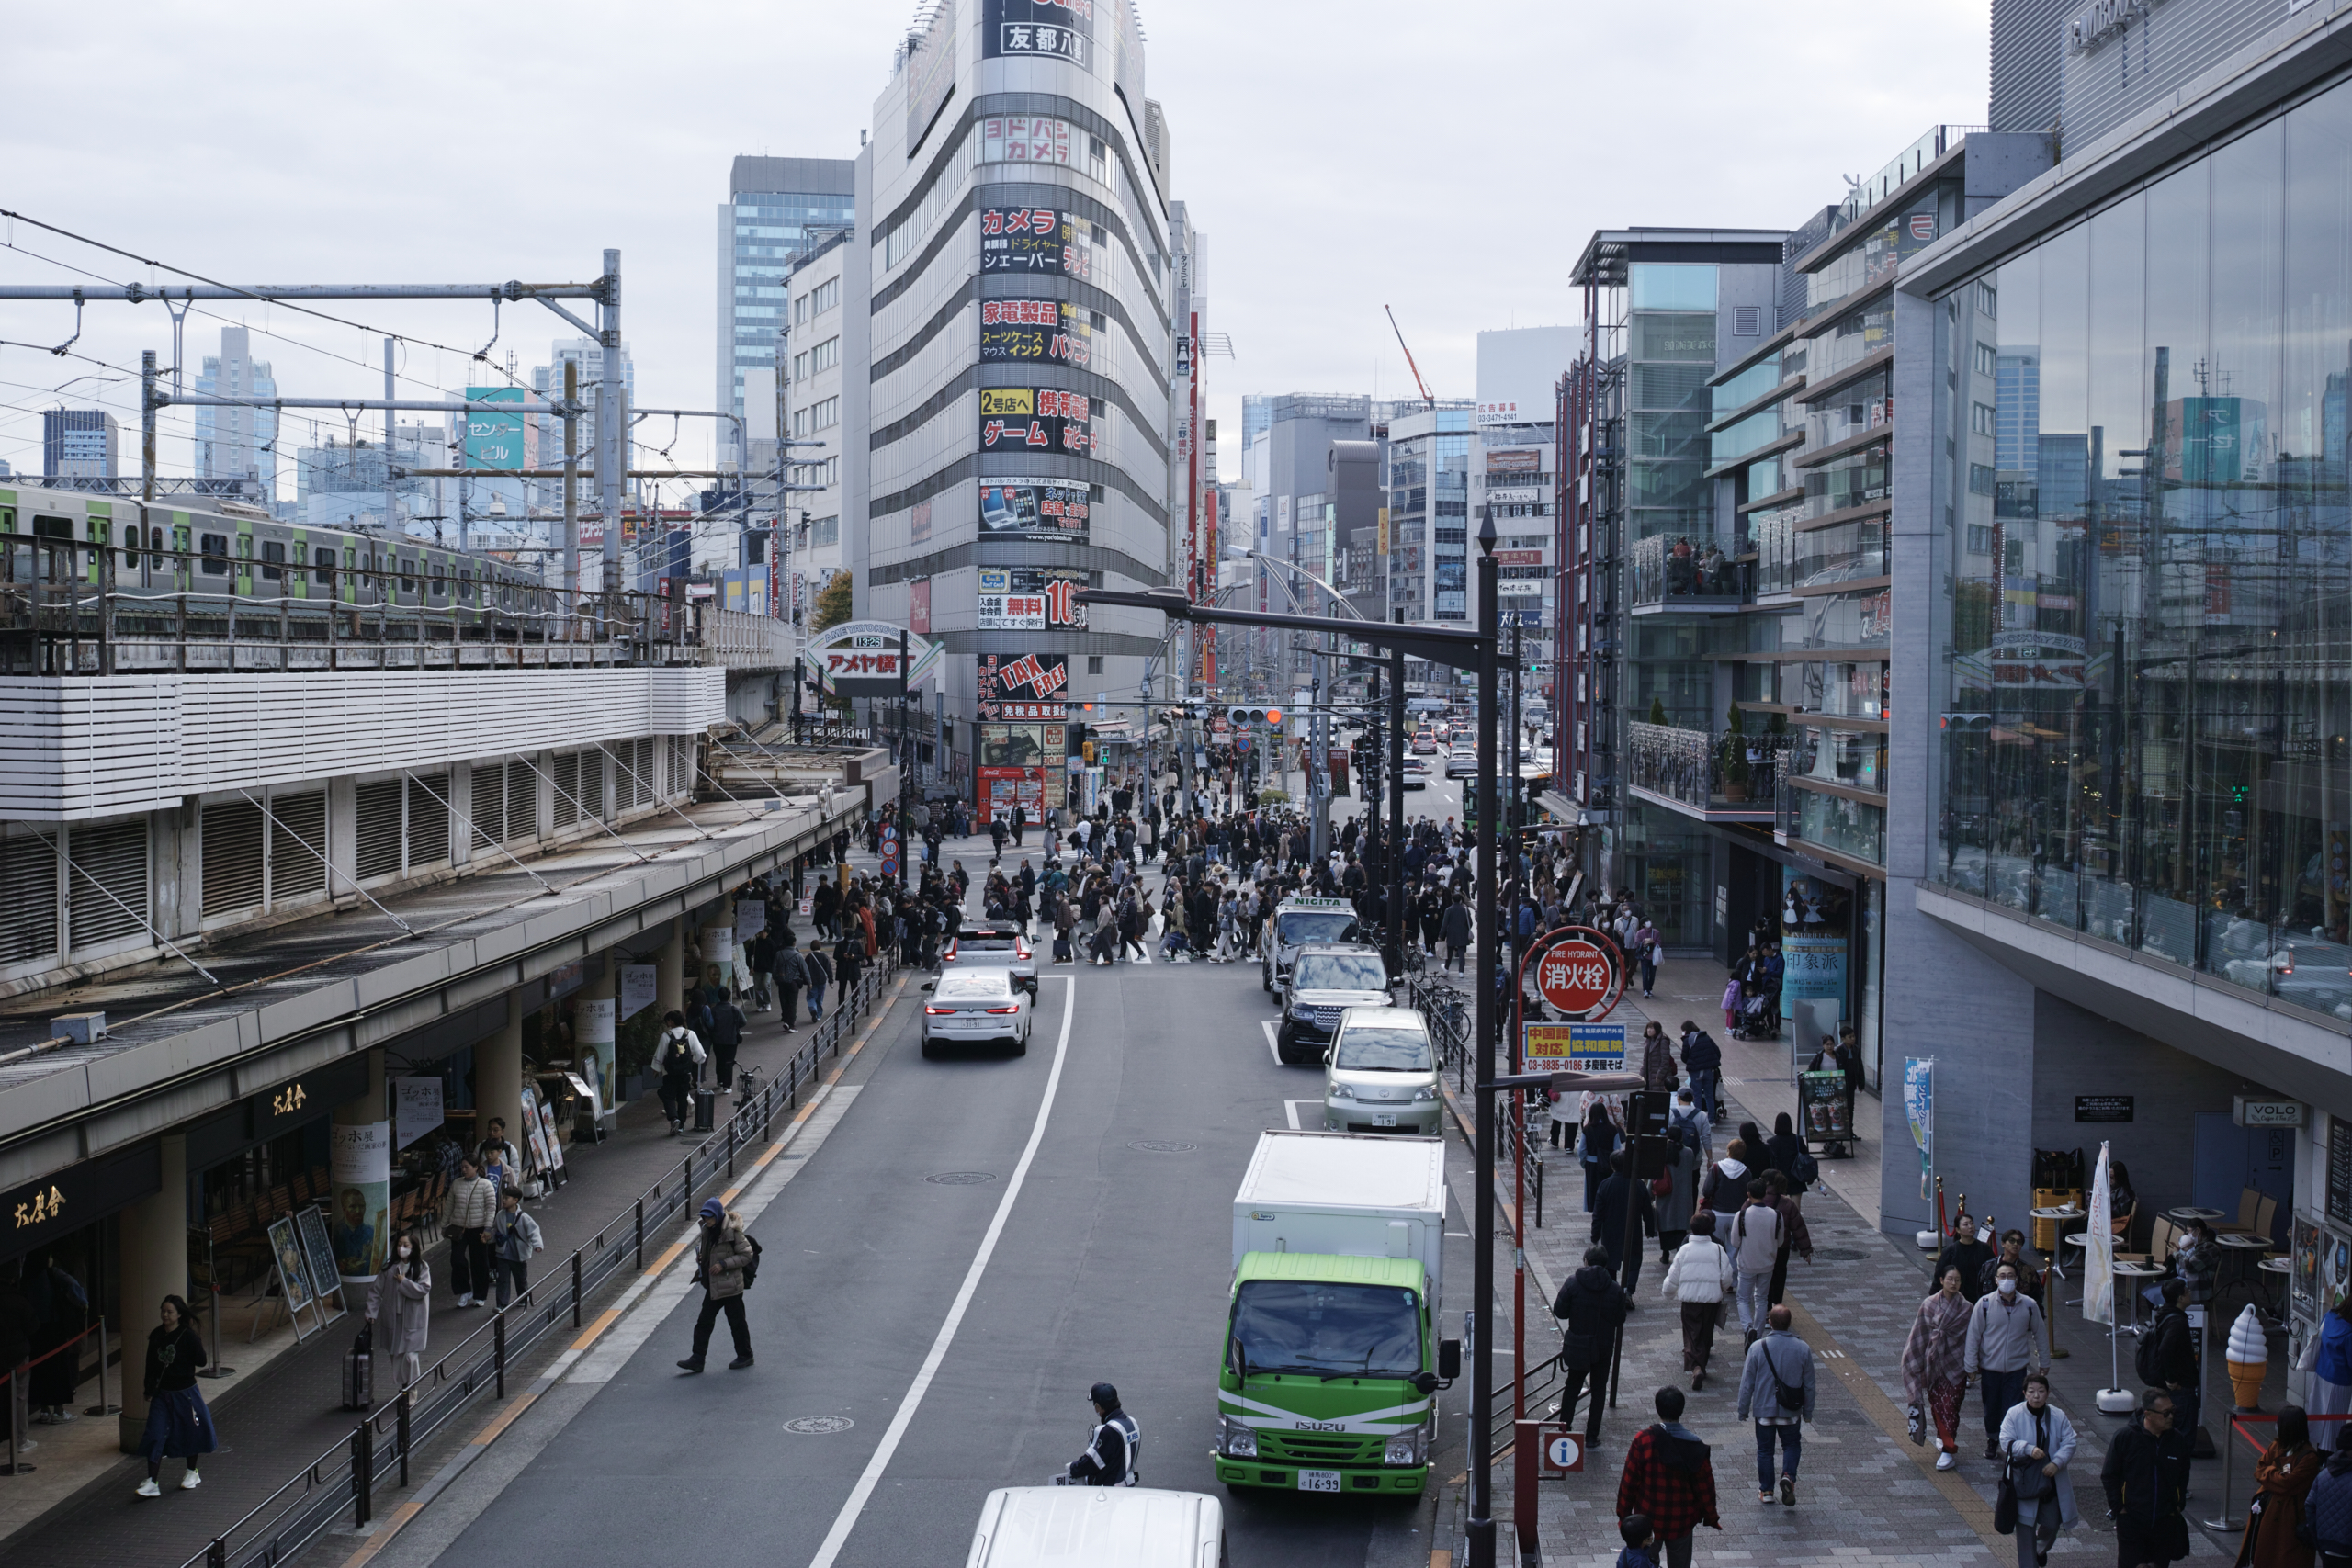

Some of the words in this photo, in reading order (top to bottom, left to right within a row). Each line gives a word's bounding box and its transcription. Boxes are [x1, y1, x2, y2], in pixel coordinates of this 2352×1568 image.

[1009, 26, 1082, 61] 友都八喜
[986, 119, 1068, 140] ヨドバシ
[1008, 142, 1068, 163] カメラ
[982, 209, 1055, 235] カメラ
[1012, 238, 1059, 251] ドライヤー
[985, 253, 1057, 268] シェーバー
[1063, 245, 1089, 276] テレビ
[983, 300, 1057, 326] 家電製品
[1061, 319, 1079, 332] エアコン
[982, 331, 1043, 344] スーツケース
[983, 346, 1006, 356] マウス
[1010, 344, 1043, 357] インク
[1049, 334, 1090, 365] パソコン
[982, 392, 1029, 413] 2号店へ
[1038, 389, 1088, 423] 携帯電話
[1478, 402, 1516, 413] 広告募集
[1478, 413, 1517, 423] 03-3471-4141
[469, 423, 521, 436] センター
[984, 420, 1048, 446] ゲーム
[1063, 424, 1089, 450] ホビー
[1178, 421, 1186, 457] 上野歯科
[481, 445, 509, 460] ビル
[980, 598, 1002, 606] 入会金
[1007, 598, 1043, 615] 無料
[980, 607, 1002, 616] 年会費
[979, 618, 1044, 627] 店頭にてすぐ発行
[857, 637, 881, 647] 13:26
[987, 655, 997, 698] ヨドバシ
[999, 654, 1045, 691] TAX
[978, 666, 987, 698] カメラ
[1031, 662, 1067, 699] FREE
[1053, 691, 1067, 699] STORE
[978, 701, 990, 713] TAX
[985, 704, 999, 716] FREE
[1295, 897, 1340, 907] NIGITA
[1551, 950, 1566, 958] FIRE
[1567, 950, 1598, 959] HYDRANT
[1786, 953, 1838, 970] 印象派
[625, 971, 653, 980] ゴッホ展
[1545, 963, 1605, 990] 消火栓
[1529, 1027, 1569, 1040] 中国語
[1535, 1043, 1564, 1055] 対応
[1572, 1040, 1623, 1052] 協和医院
[1528, 1059, 1583, 1071] 03-3835-0186
[1584, 1059, 1623, 1071] 多慶屋そば
[401, 1085, 440, 1097] ゴッホ展
[2254, 1106, 2296, 1114] VOLO
[1295, 1420, 1345, 1432] ISUZU
[1308, 1479, 1339, 1490] 16-99
